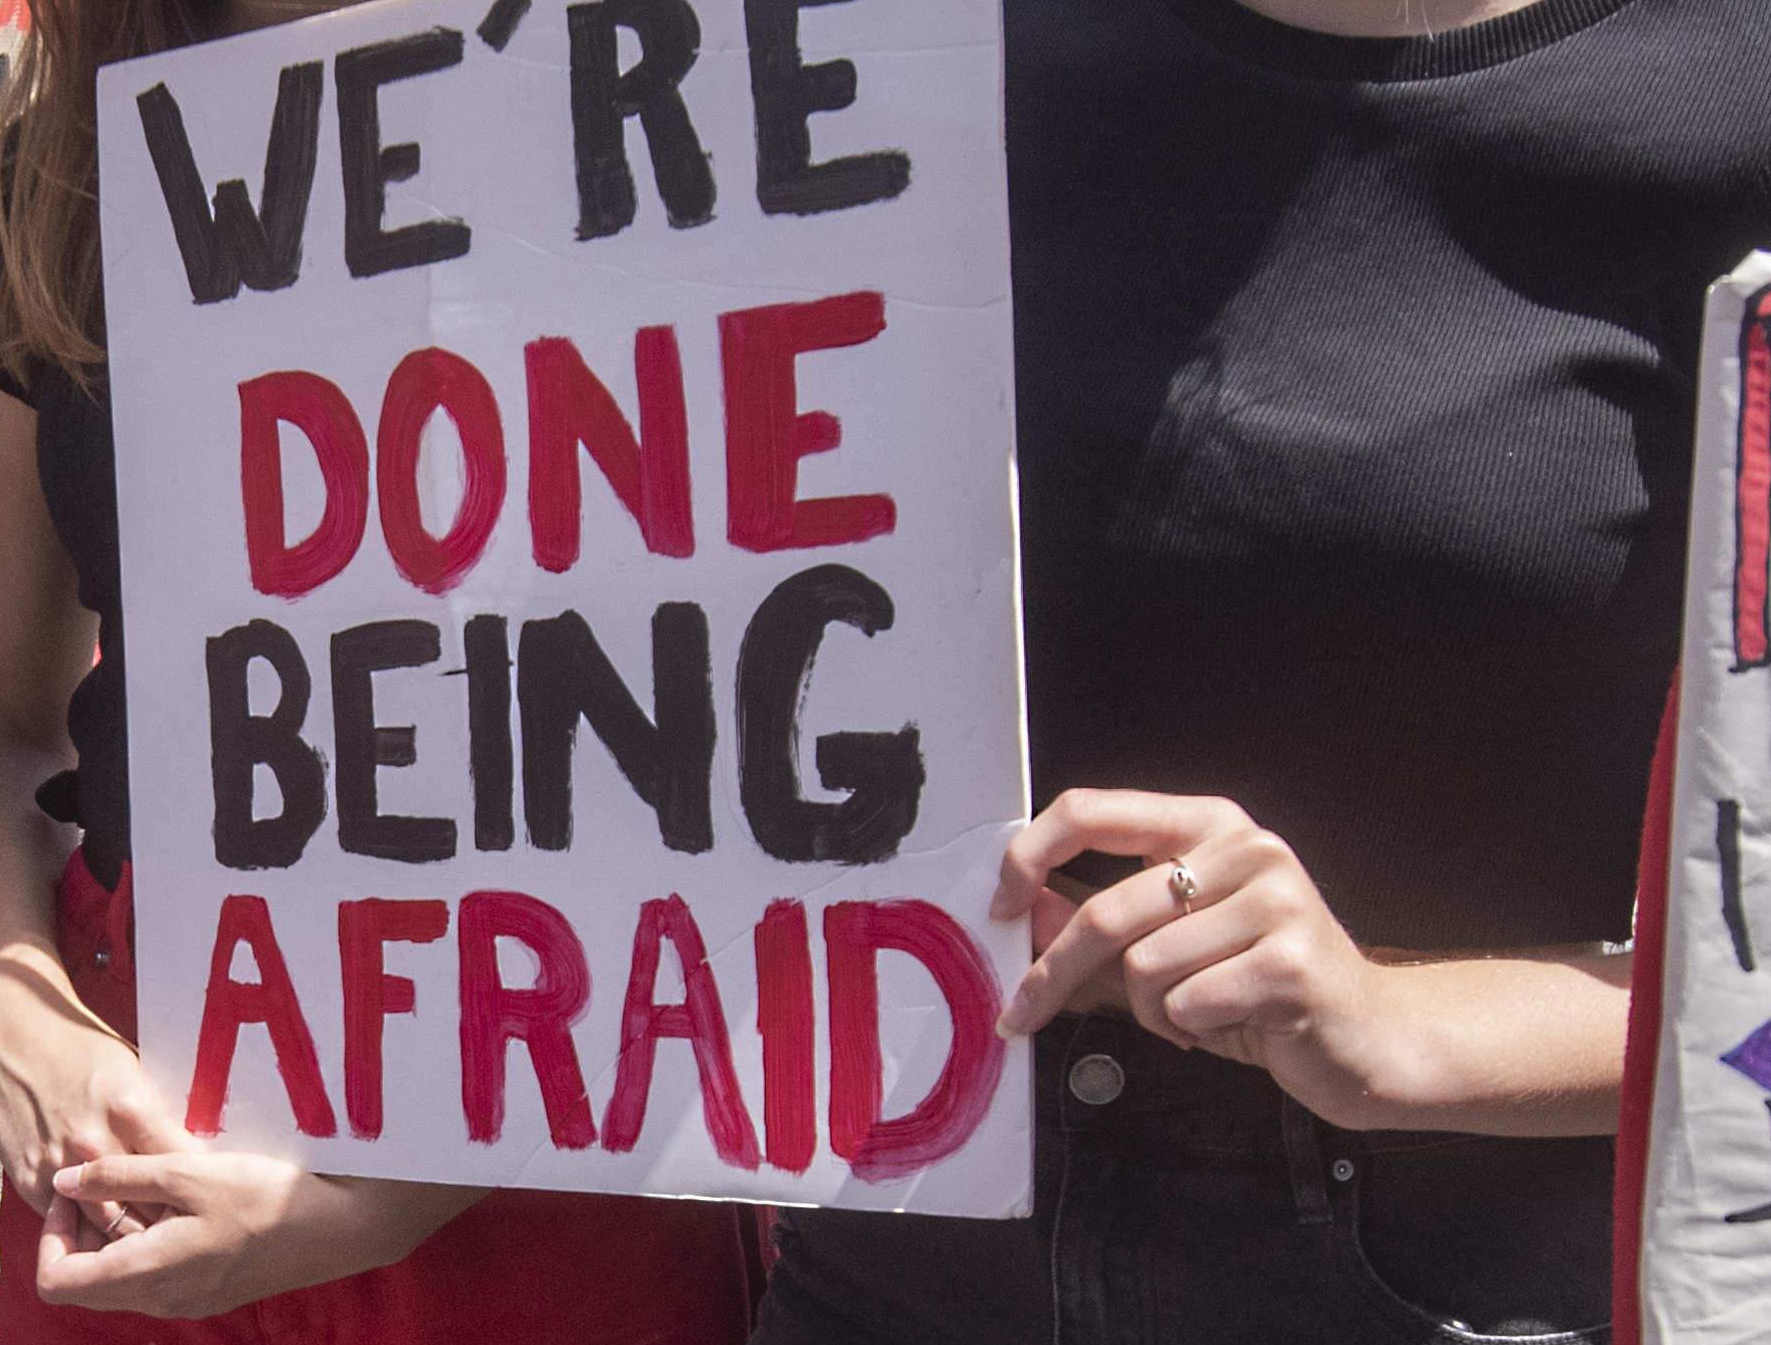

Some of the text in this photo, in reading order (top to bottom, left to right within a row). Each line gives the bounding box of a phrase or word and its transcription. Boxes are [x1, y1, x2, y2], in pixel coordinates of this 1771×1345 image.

[236, 290, 898, 599] DONE
[204, 563, 927, 871] BEING
[183, 888, 1006, 1185] AFRAID
